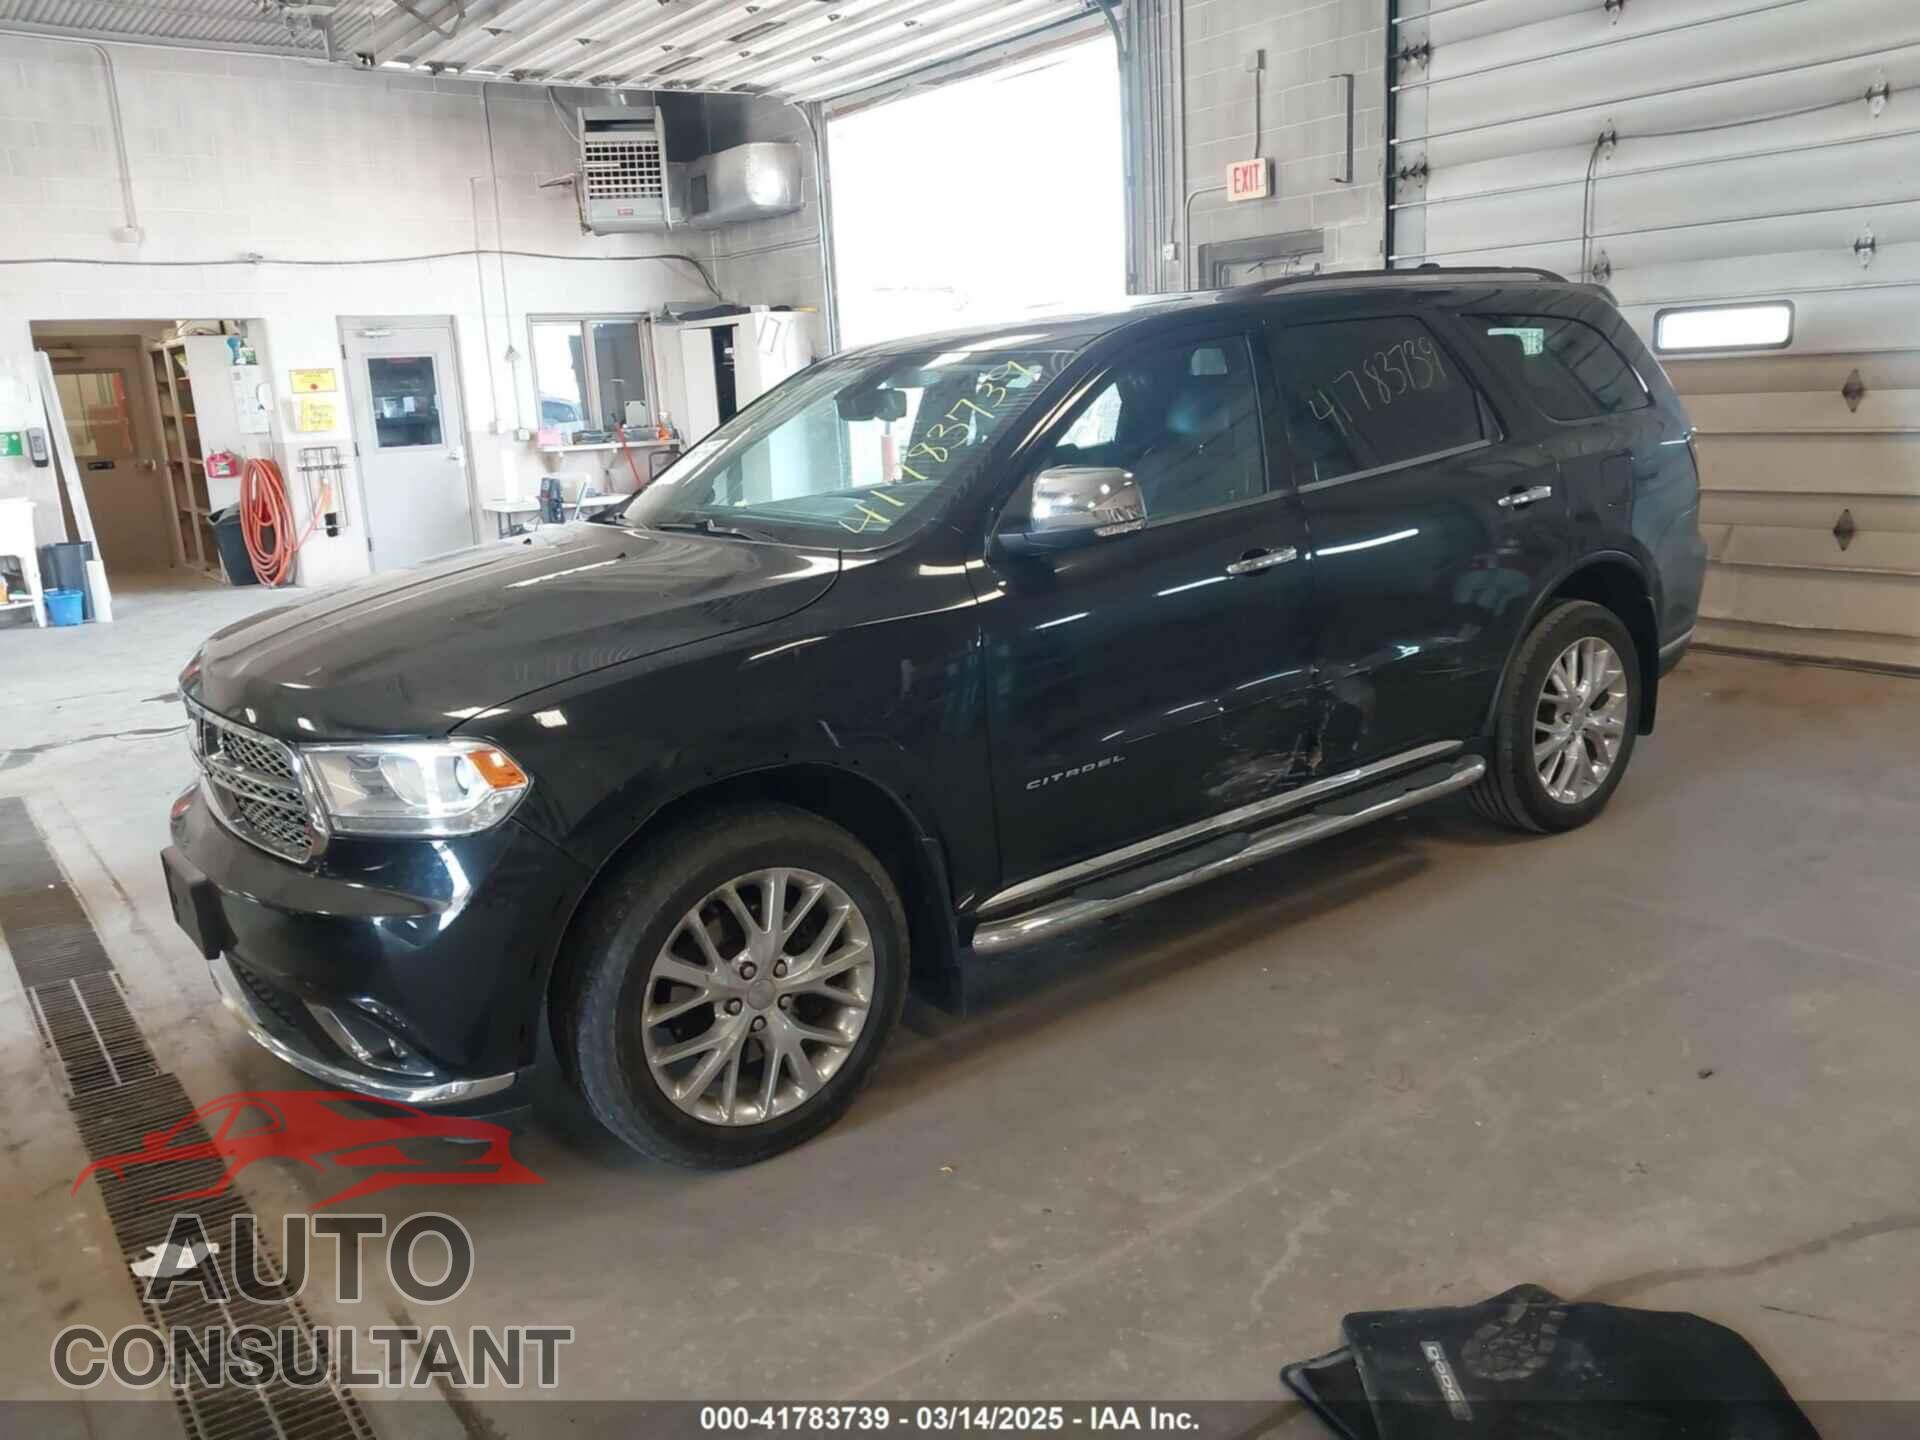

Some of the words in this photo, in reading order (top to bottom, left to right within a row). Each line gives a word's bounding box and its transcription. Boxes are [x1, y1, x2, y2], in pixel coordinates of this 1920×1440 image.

[1233, 163, 1261, 194] EXIT
[1308, 337, 1447, 436] 41783739
[1026, 755, 1126, 790] CITADEL
[1426, 1345, 1463, 1412] DODG
